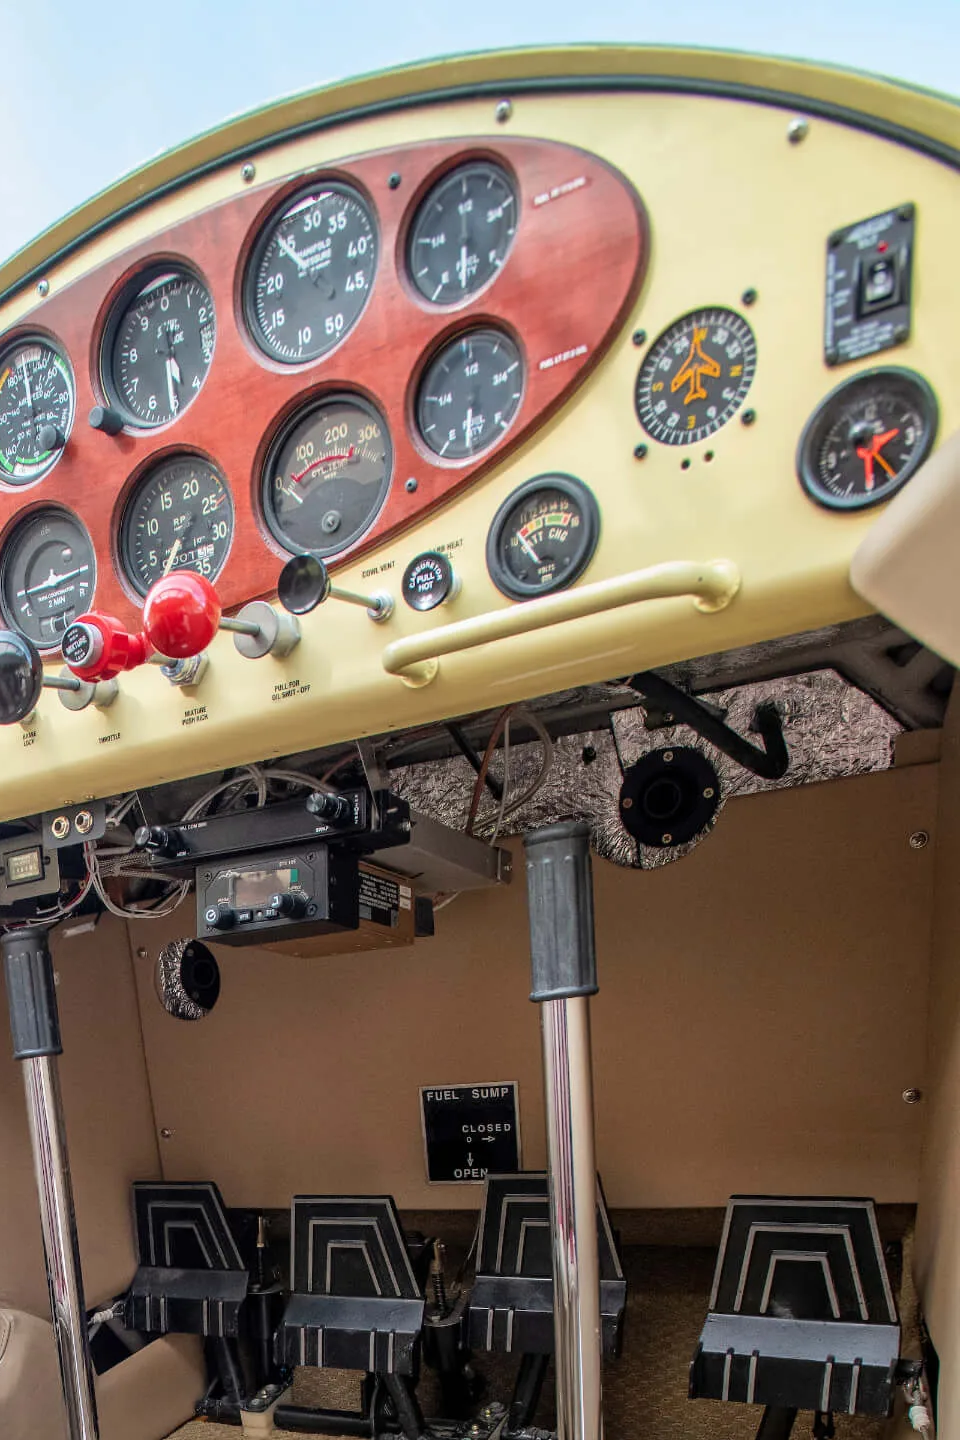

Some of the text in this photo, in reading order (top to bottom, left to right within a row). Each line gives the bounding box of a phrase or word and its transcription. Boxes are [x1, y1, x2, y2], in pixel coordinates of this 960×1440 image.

[303, 210, 321, 232] 30
[327, 211, 347, 234] 35
[347, 238, 367, 258] 40
[267, 273, 283, 294] 20
[345, 270, 365, 292] 45
[160, 296, 169, 311] 0
[186, 294, 190, 308] 1
[198, 307, 207, 323] 2
[272, 309, 285, 328] 15
[140, 316, 149, 331] 9
[325, 313, 343, 334] 50
[298, 327, 311, 345] 10
[130, 348, 138, 363] 8
[203, 348, 211, 363] 3
[464, 362, 479, 377] 1/2
[131, 377, 139, 393] 7
[192, 375, 201, 388] 4
[493, 371, 508, 386] 3/4
[651, 381, 664, 392] S
[59, 392, 69, 404] 80
[148, 395, 157, 410] 6
[439, 392, 452, 407] 1/4
[494, 412, 502, 424] F
[324, 423, 348, 445] 200
[357, 423, 381, 444] 300
[449, 429, 456, 441] E
[905, 426, 915, 446] 3
[296, 442, 314, 461] 100
[182, 479, 199, 499] 20
[275, 477, 283, 491] 0
[161, 492, 172, 511] 15
[202, 494, 217, 515] 25
[147, 518, 159, 536] 10
[212, 521, 227, 540] 30
[548, 528, 569, 542] CHG
[447, 538, 463, 550] HEAT
[149, 550, 158, 566] 5
[196, 561, 211, 575] 35
[362, 561, 395, 579] COWL VENT
[409, 559, 442, 589] CARBURETOR
[416, 572, 435, 584] PULL
[418, 580, 434, 592] HOT
[274, 683, 288, 692] PULL
[300, 684, 311, 693] OFF
[426, 1087, 509, 1101] FUEL SUMP
[462, 1123, 511, 1133] CLOSED
[453, 1168, 488, 1178] OPEN
